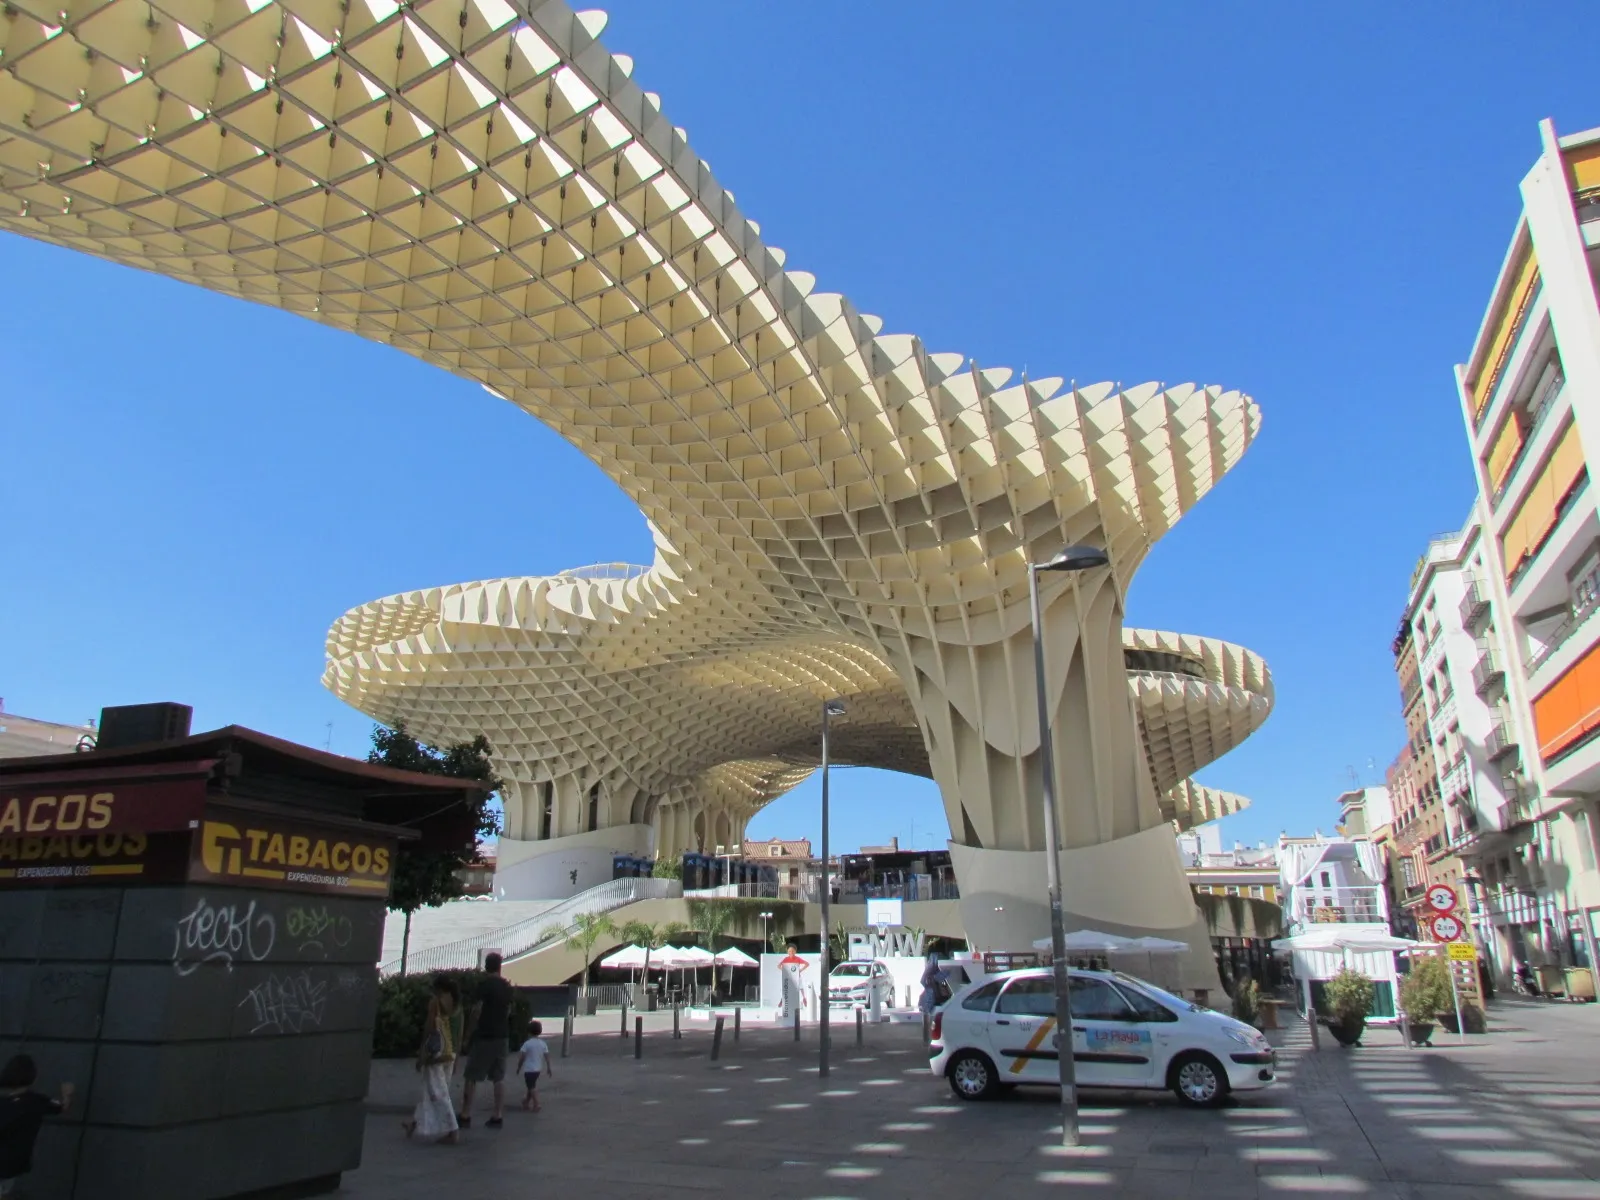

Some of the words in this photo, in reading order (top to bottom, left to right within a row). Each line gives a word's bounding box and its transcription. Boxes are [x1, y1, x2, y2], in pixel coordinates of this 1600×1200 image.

[245, 829, 390, 876] TABACOS
[287, 871, 336, 885] EXPENDEDURIA
[1095, 1030, 1108, 1040] La
